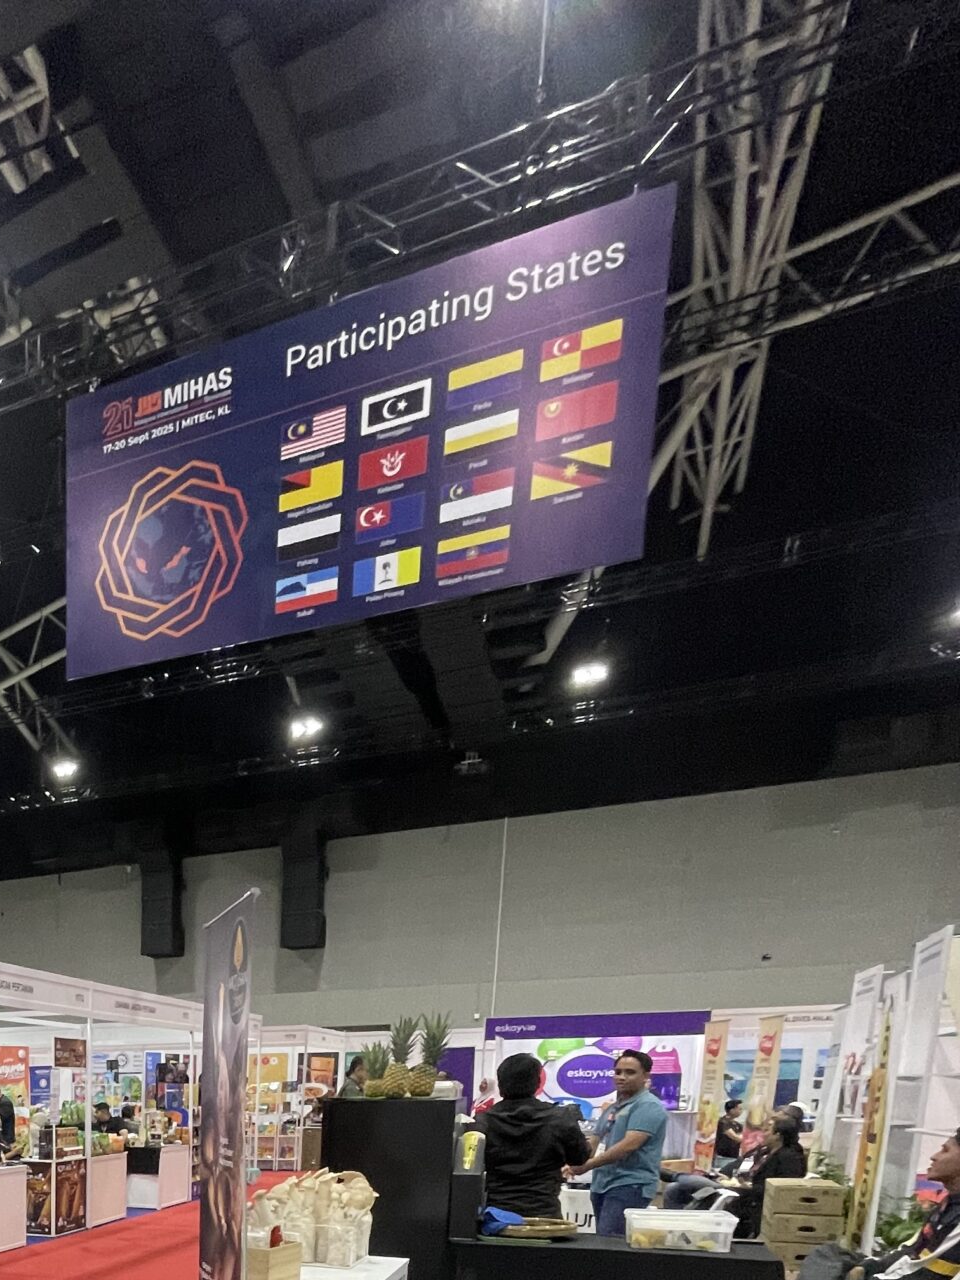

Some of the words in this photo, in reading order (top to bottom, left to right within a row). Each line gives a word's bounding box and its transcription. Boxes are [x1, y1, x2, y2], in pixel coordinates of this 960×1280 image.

[285, 285, 494, 377] Participating
[506, 241, 626, 301] States
[164, 367, 233, 409] MIHAS
[103, 439, 126, 454] 17-20
[127, 433, 149, 447] Sept
[151, 423, 174, 438] 2025
[181, 411, 215, 429] MITEC,
[217, 404, 231, 417] KL
[495, 1023, 537, 1033] eskayvie
[567, 1068, 615, 1079] eskayvie
